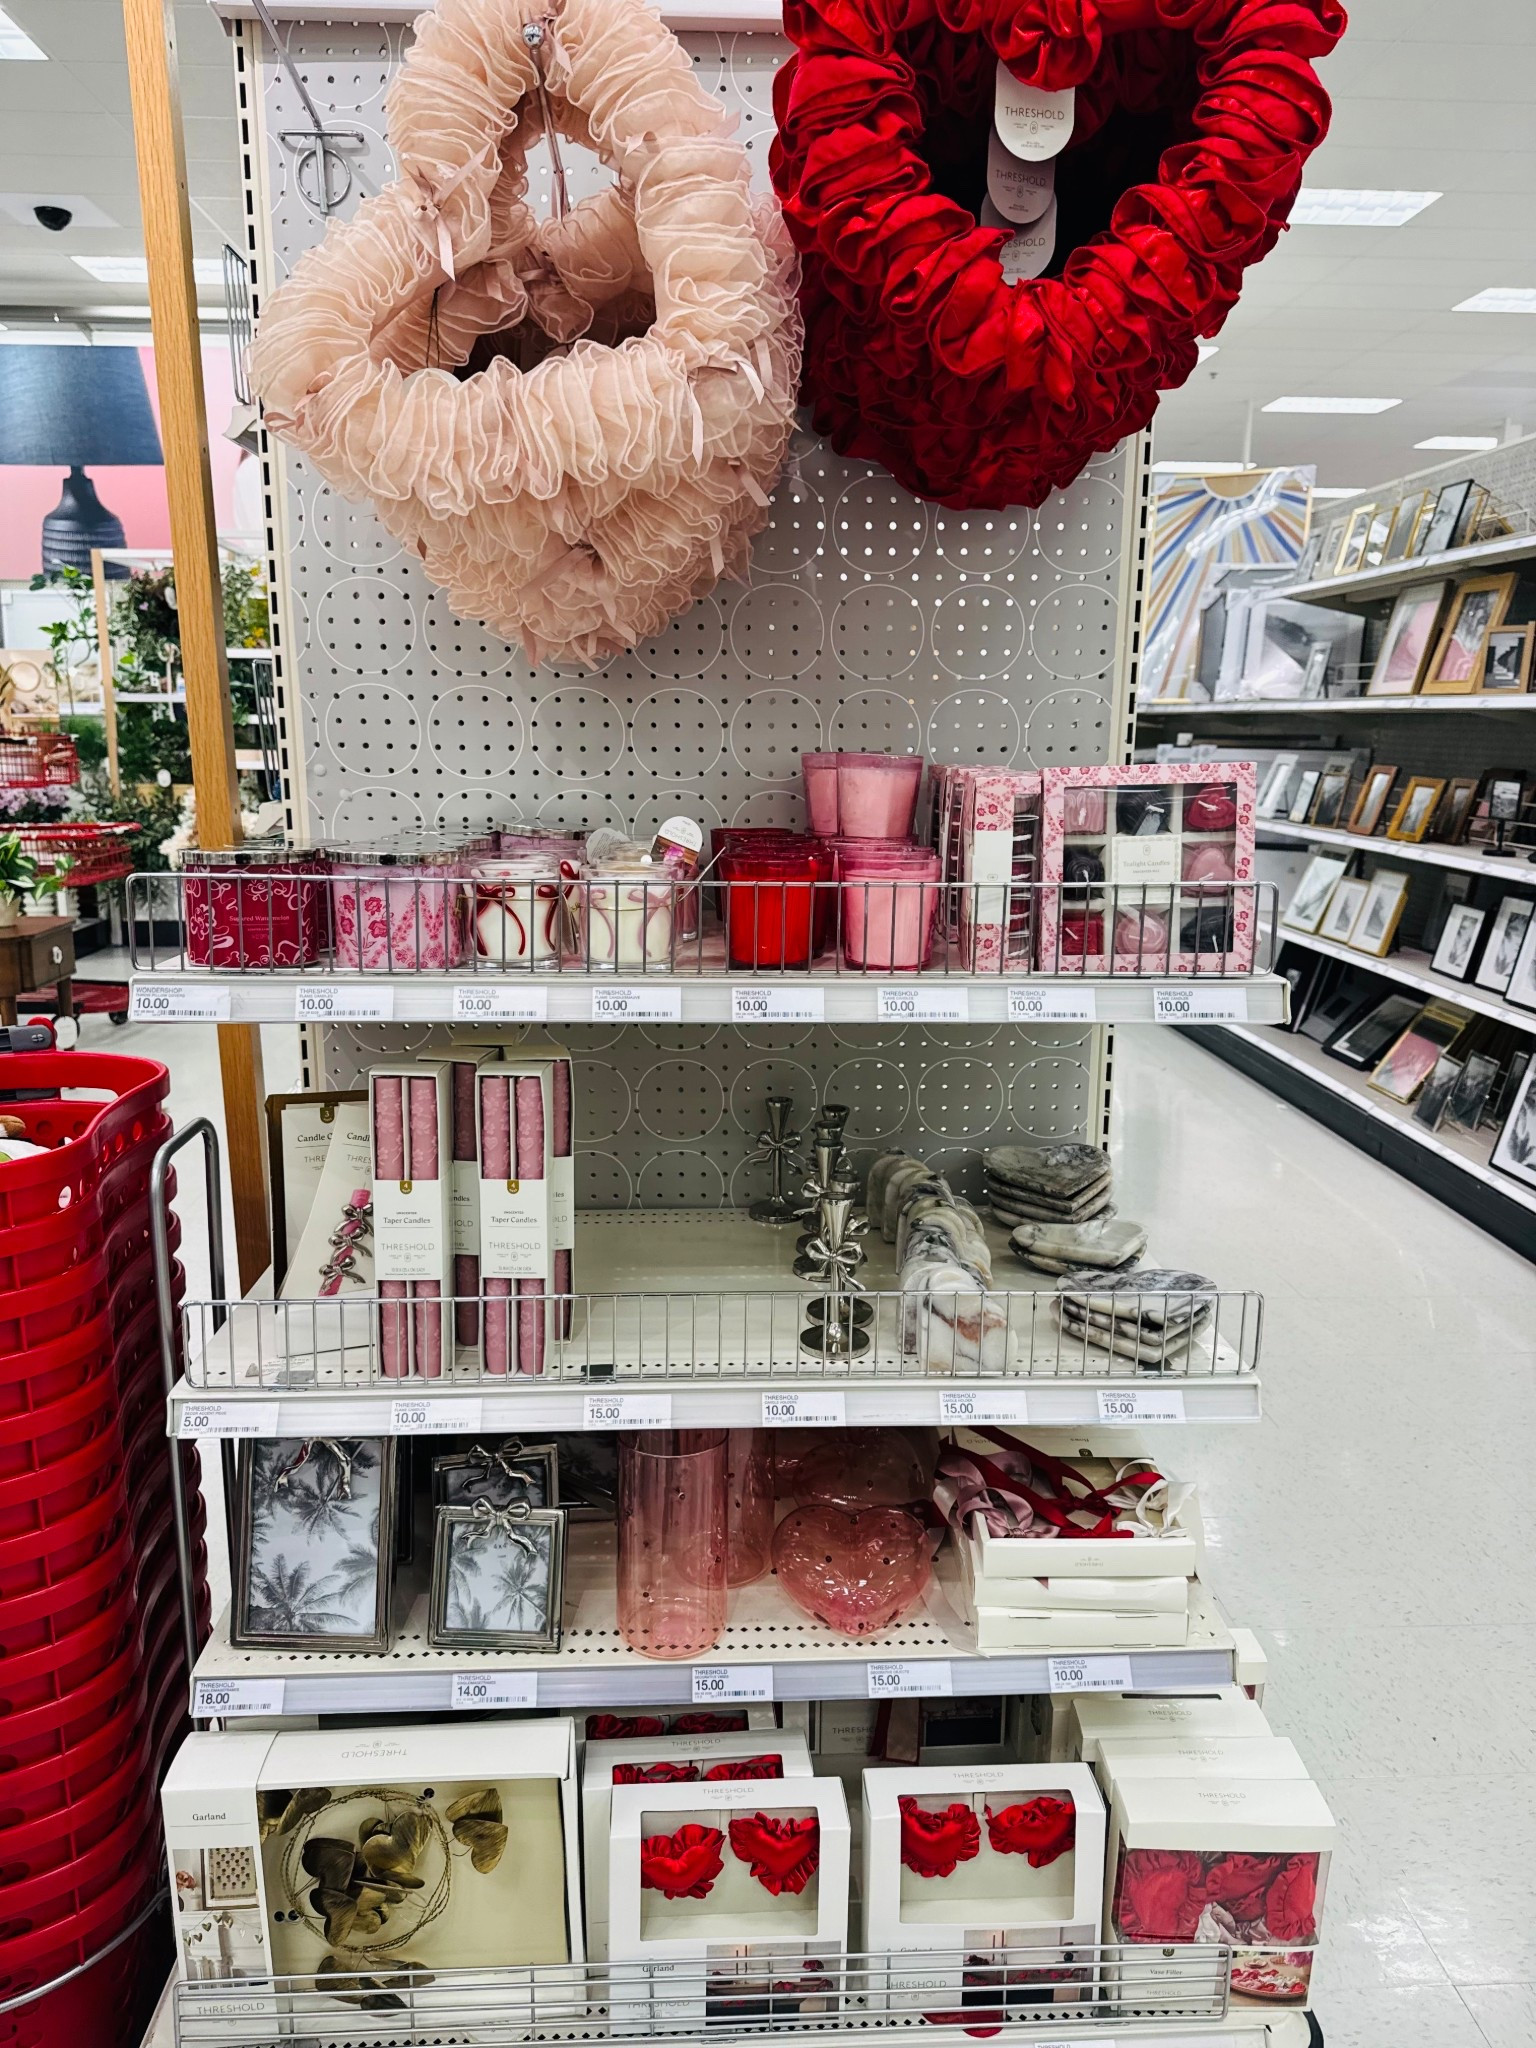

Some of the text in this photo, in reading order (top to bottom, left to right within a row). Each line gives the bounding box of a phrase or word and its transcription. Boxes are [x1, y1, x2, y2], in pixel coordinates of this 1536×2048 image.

[1005, 106, 1065, 120] THRESHOLD
[996, 169, 1046, 187] THRESHOLD
[1005, 237, 1046, 248] ESHOLD
[136, 998, 169, 1009] 10.00
[300, 998, 333, 1010] 10.00
[459, 999, 492, 1010] 10.00
[596, 1000, 627, 1011] 10.00
[736, 1000, 768, 1011] 10.00
[883, 1001, 915, 1011] 10.00
[1011, 1001, 1043, 1011] 10.00
[1158, 1001, 1190, 1012] 10.00
[297, 1133, 326, 1142] Candle
[347, 1154, 371, 1164] THRES
[384, 1217, 402, 1225] Taper
[491, 1216, 509, 1224] Taper
[381, 1243, 435, 1251] THRESHOLD
[488, 1242, 541, 1250] THRESHOLD
[589, 1408, 620, 1419] 15.00
[765, 1405, 795, 1416] 10.00
[943, 1403, 974, 1414] 15.00
[1104, 1403, 1134, 1414] 15.00
[183, 1416, 209, 1427] 5.00
[395, 1412, 426, 1423] 10.00
[871, 1675, 900, 1686] 15.00
[1055, 1670, 1083, 1681] 10.00
[458, 1685, 487, 1696] 14.00
[695, 1680, 724, 1691] 15.00
[200, 1693, 230, 1704] 18.00
[672, 1739, 721, 1747] THRESHOLD
[341, 1748, 407, 1758] THRESHOLD
[192, 1812, 226, 1821] Garland
[642, 1965, 675, 1973] Grland
[886, 1980, 947, 1989] HRESHOLD
[196, 2002, 265, 2015] THRESHOLD
